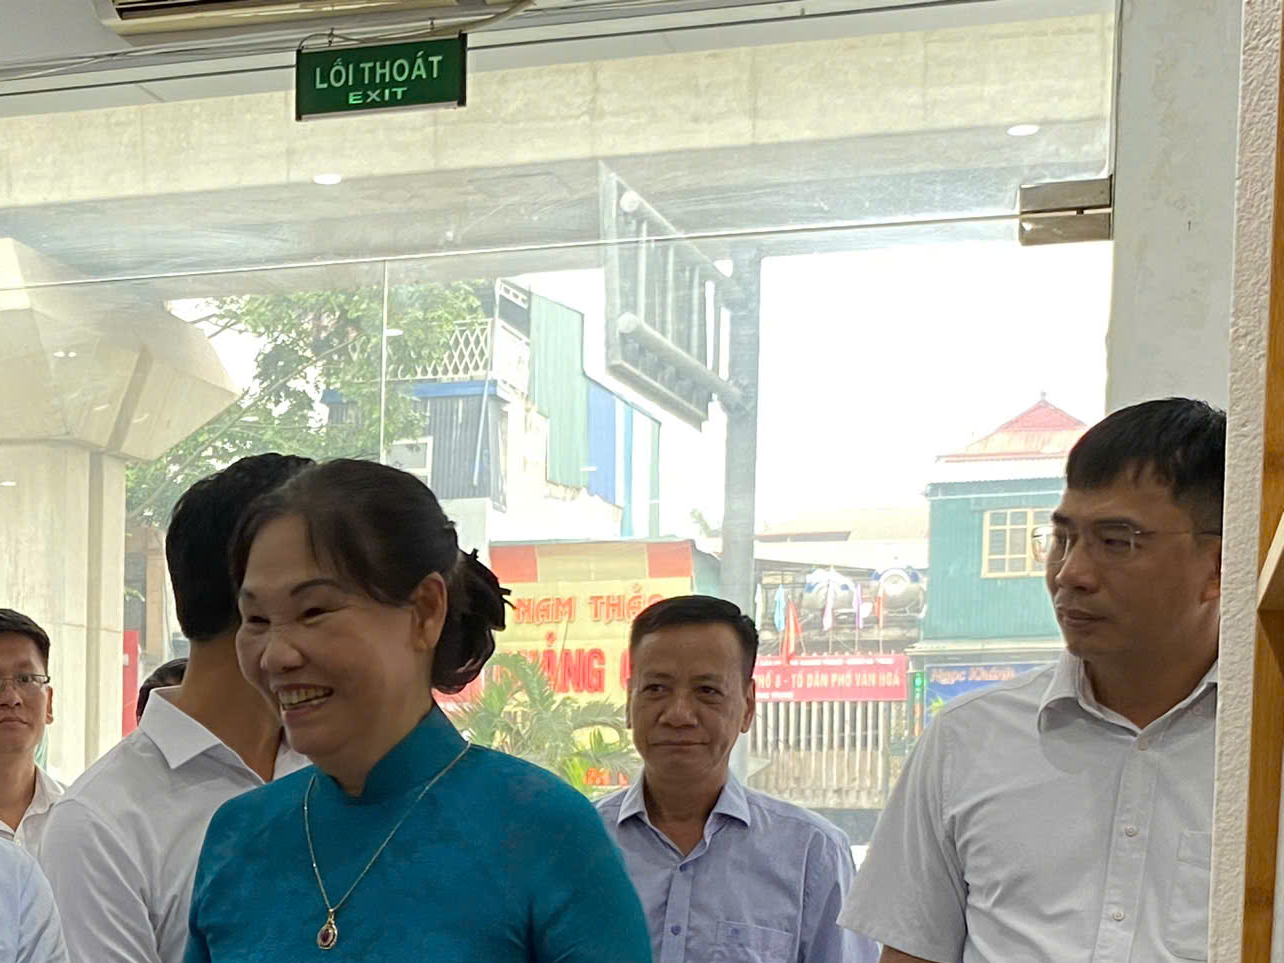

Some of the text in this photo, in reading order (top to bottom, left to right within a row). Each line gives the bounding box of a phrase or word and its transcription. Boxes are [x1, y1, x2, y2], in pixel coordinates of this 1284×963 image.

[315, 50, 443, 89] LỐI THOÁT
[348, 87, 408, 105] EXIT
